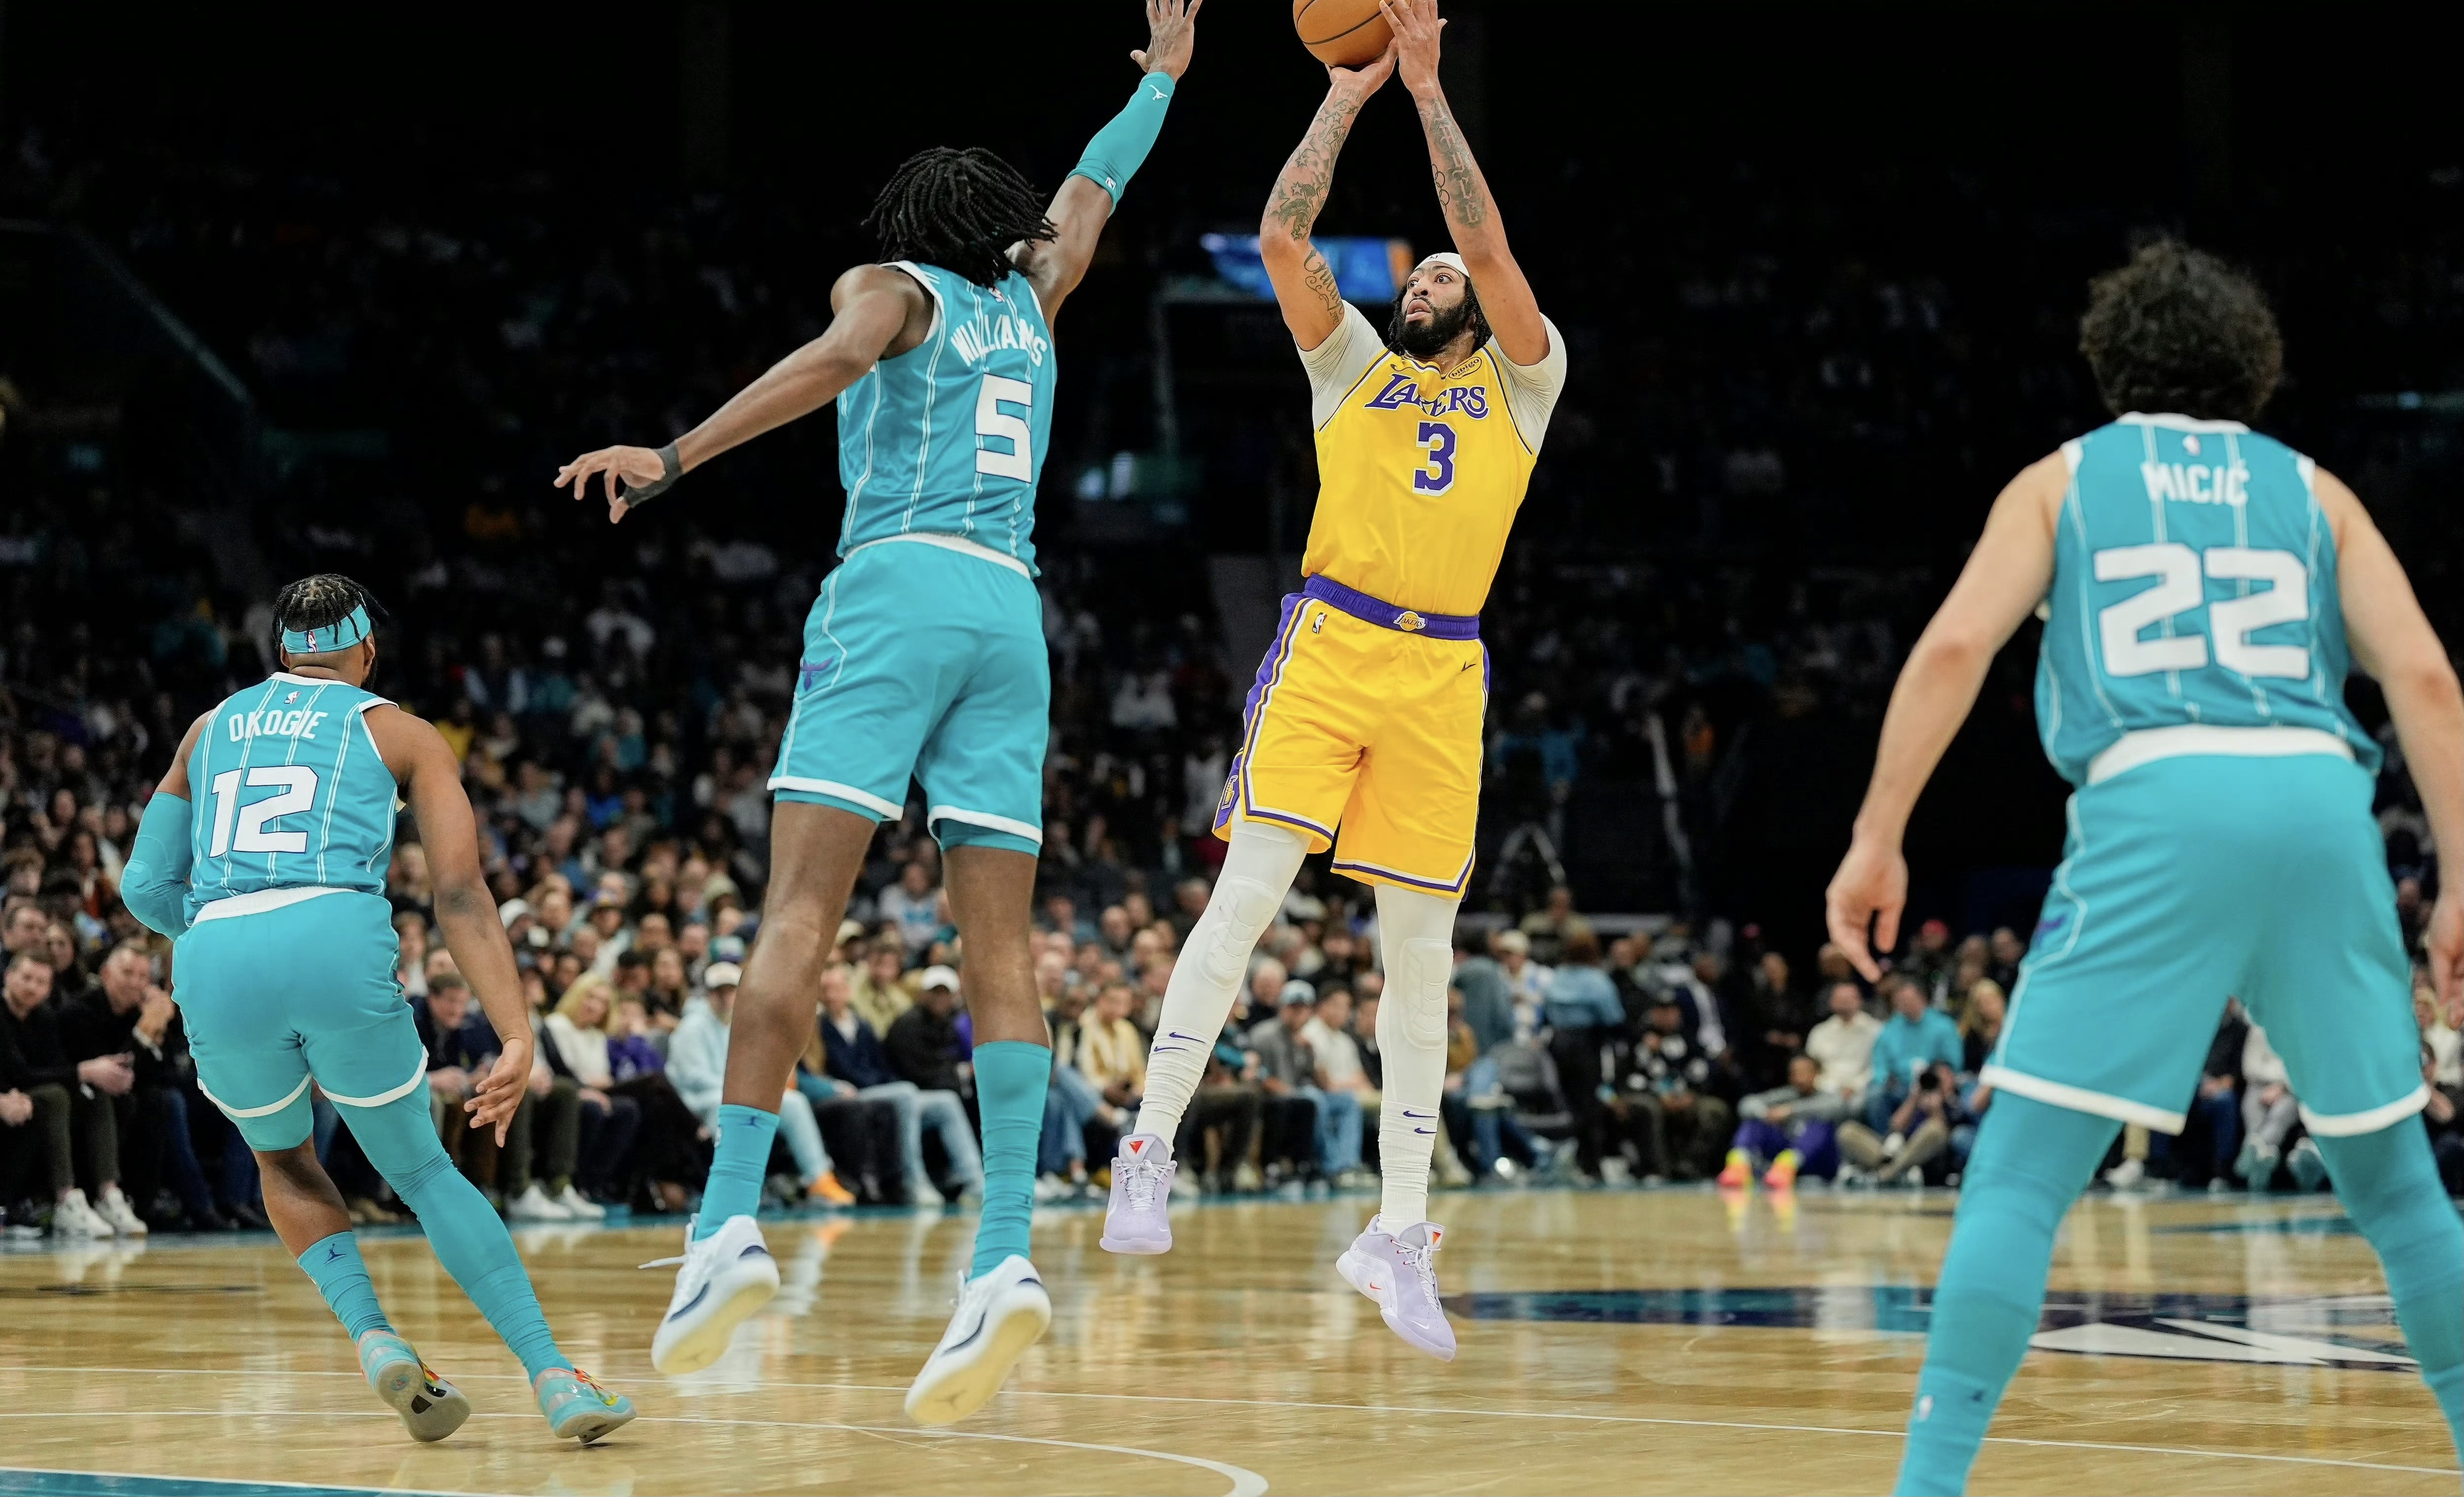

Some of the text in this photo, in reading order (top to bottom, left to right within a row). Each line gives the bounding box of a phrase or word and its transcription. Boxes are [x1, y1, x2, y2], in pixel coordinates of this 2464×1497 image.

[950, 314, 1047, 367] WILLIAMS
[1452, 359, 1479, 377] bibigo
[975, 373, 1033, 483] 5
[1413, 420, 1457, 496] 3
[2094, 543, 2309, 679] 22
[228, 710, 327, 742] OKOGIE
[209, 765, 319, 858] 12
